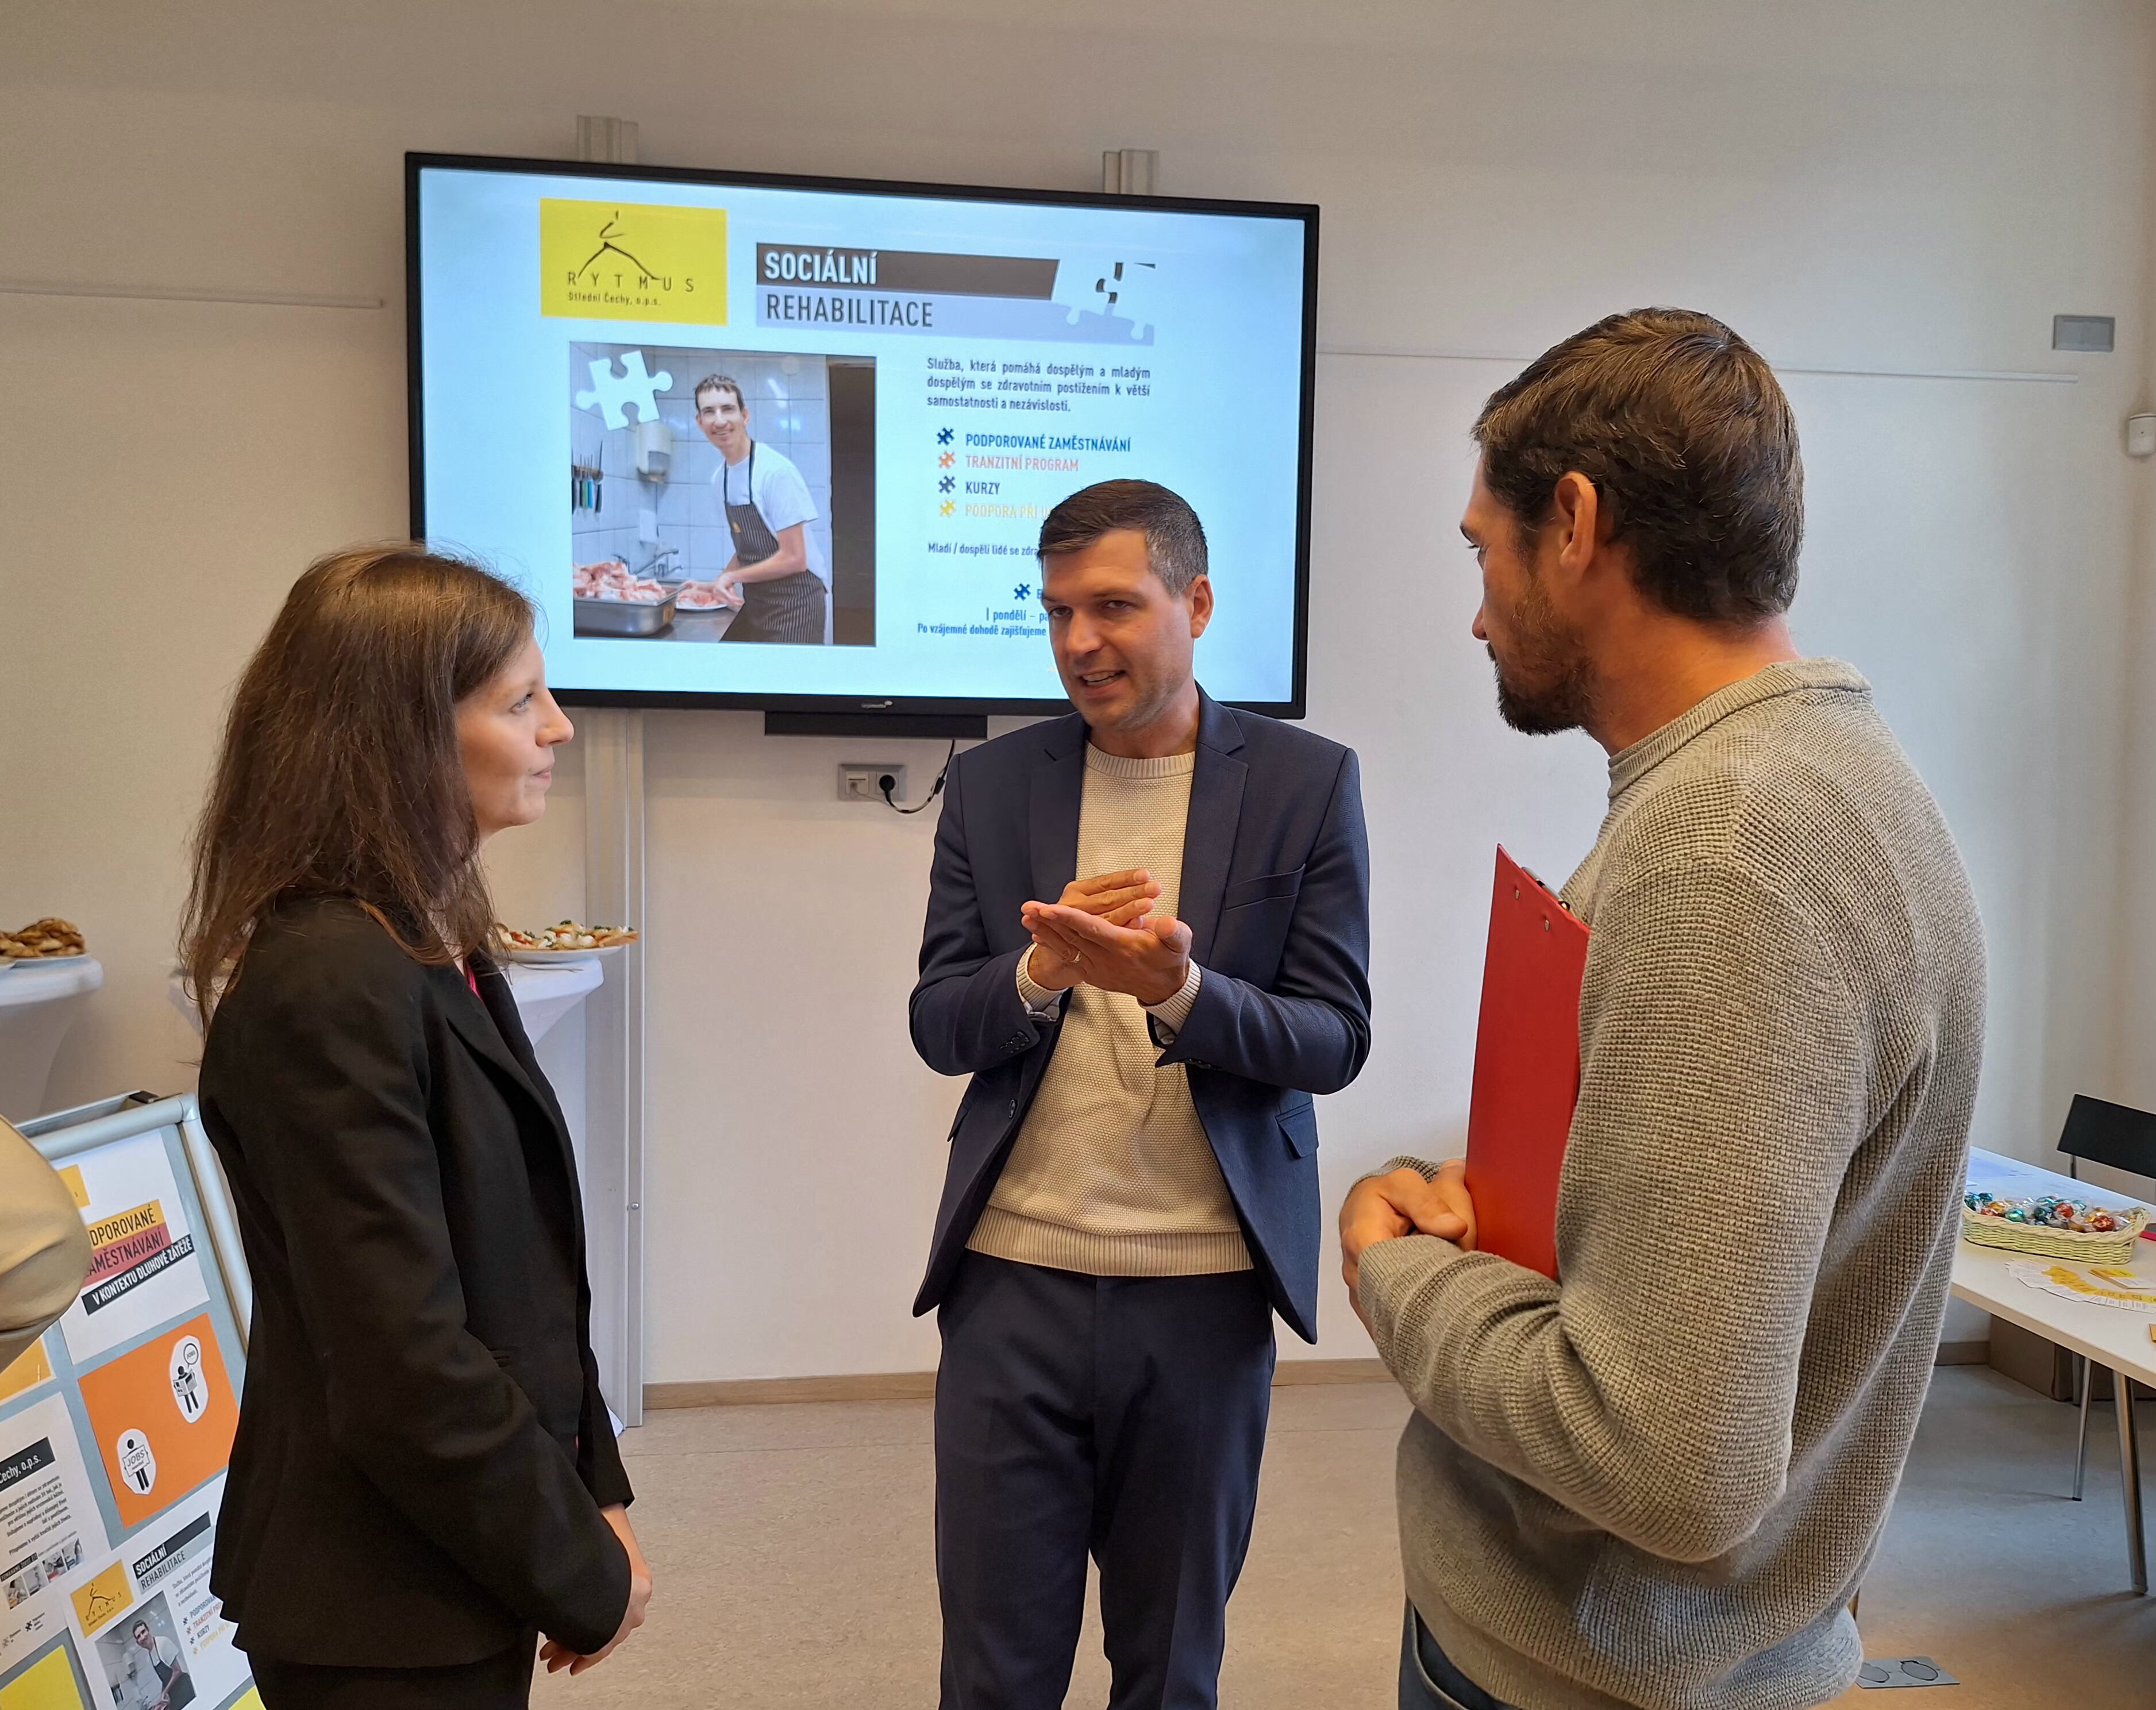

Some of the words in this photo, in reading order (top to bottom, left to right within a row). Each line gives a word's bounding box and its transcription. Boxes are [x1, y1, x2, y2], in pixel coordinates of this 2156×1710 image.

[764, 249, 878, 285] SOCIÁLNÍ
[567, 271, 694, 292] RYTMUS
[767, 294, 933, 328] REHABILITACE
[927, 357, 964, 372] Služba,
[970, 359, 996, 372] která
[1002, 362, 1041, 375] pomáhá
[1047, 363, 1094, 379] dospělým
[1100, 368, 1106, 377] a
[1111, 366, 1150, 381] mladým
[927, 376, 976, 391] dospělým
[980, 380, 992, 390] se
[998, 379, 1052, 393] zdravotním
[1057, 382, 1110, 395] postižením
[1115, 384, 1121, 395] k
[1126, 384, 1150, 396] větší
[927, 396, 998, 409] samostatnosti
[1001, 400, 1007, 409] a
[1010, 398, 1071, 412] nezávislosti.
[966, 434, 1046, 449] PODPOROVANÉ
[1049, 435, 1131, 452] ZAMĚSTNÁVÁNÍ
[966, 455, 1022, 470] TRANZITNÍ
[1025, 457, 1079, 472] PROGRAM
[965, 482, 1000, 495] KURZY
[965, 504, 1017, 518] PODPORA
[928, 542, 952, 553] Mladí
[960, 544, 990, 557] dospělí
[992, 545, 1007, 555] lidé
[1010, 547, 1019, 556] se
[993, 610, 1026, 623] pondělí
[918, 623, 927, 633] Po
[930, 623, 967, 637] vzájemné
[969, 625, 999, 636] dohodě
[1001, 625, 1046, 638] zajišťujeme
[87, 1227, 164, 1277] AMĚSTNÁVÁNÍ
[92, 1293, 101, 1305] V
[98, 1270, 138, 1303] KONTEXTU
[137, 1251, 170, 1279] DLUHOVÉ
[167, 1237, 193, 1262] ZÁTĚŽE
[21, 1455, 41, 1470] o.p.s.
[126, 1449, 145, 1467] JOBS
[136, 1544, 167, 1576] SOCIÁLNÍ
[140, 1550, 186, 1590] REHABILITACE
